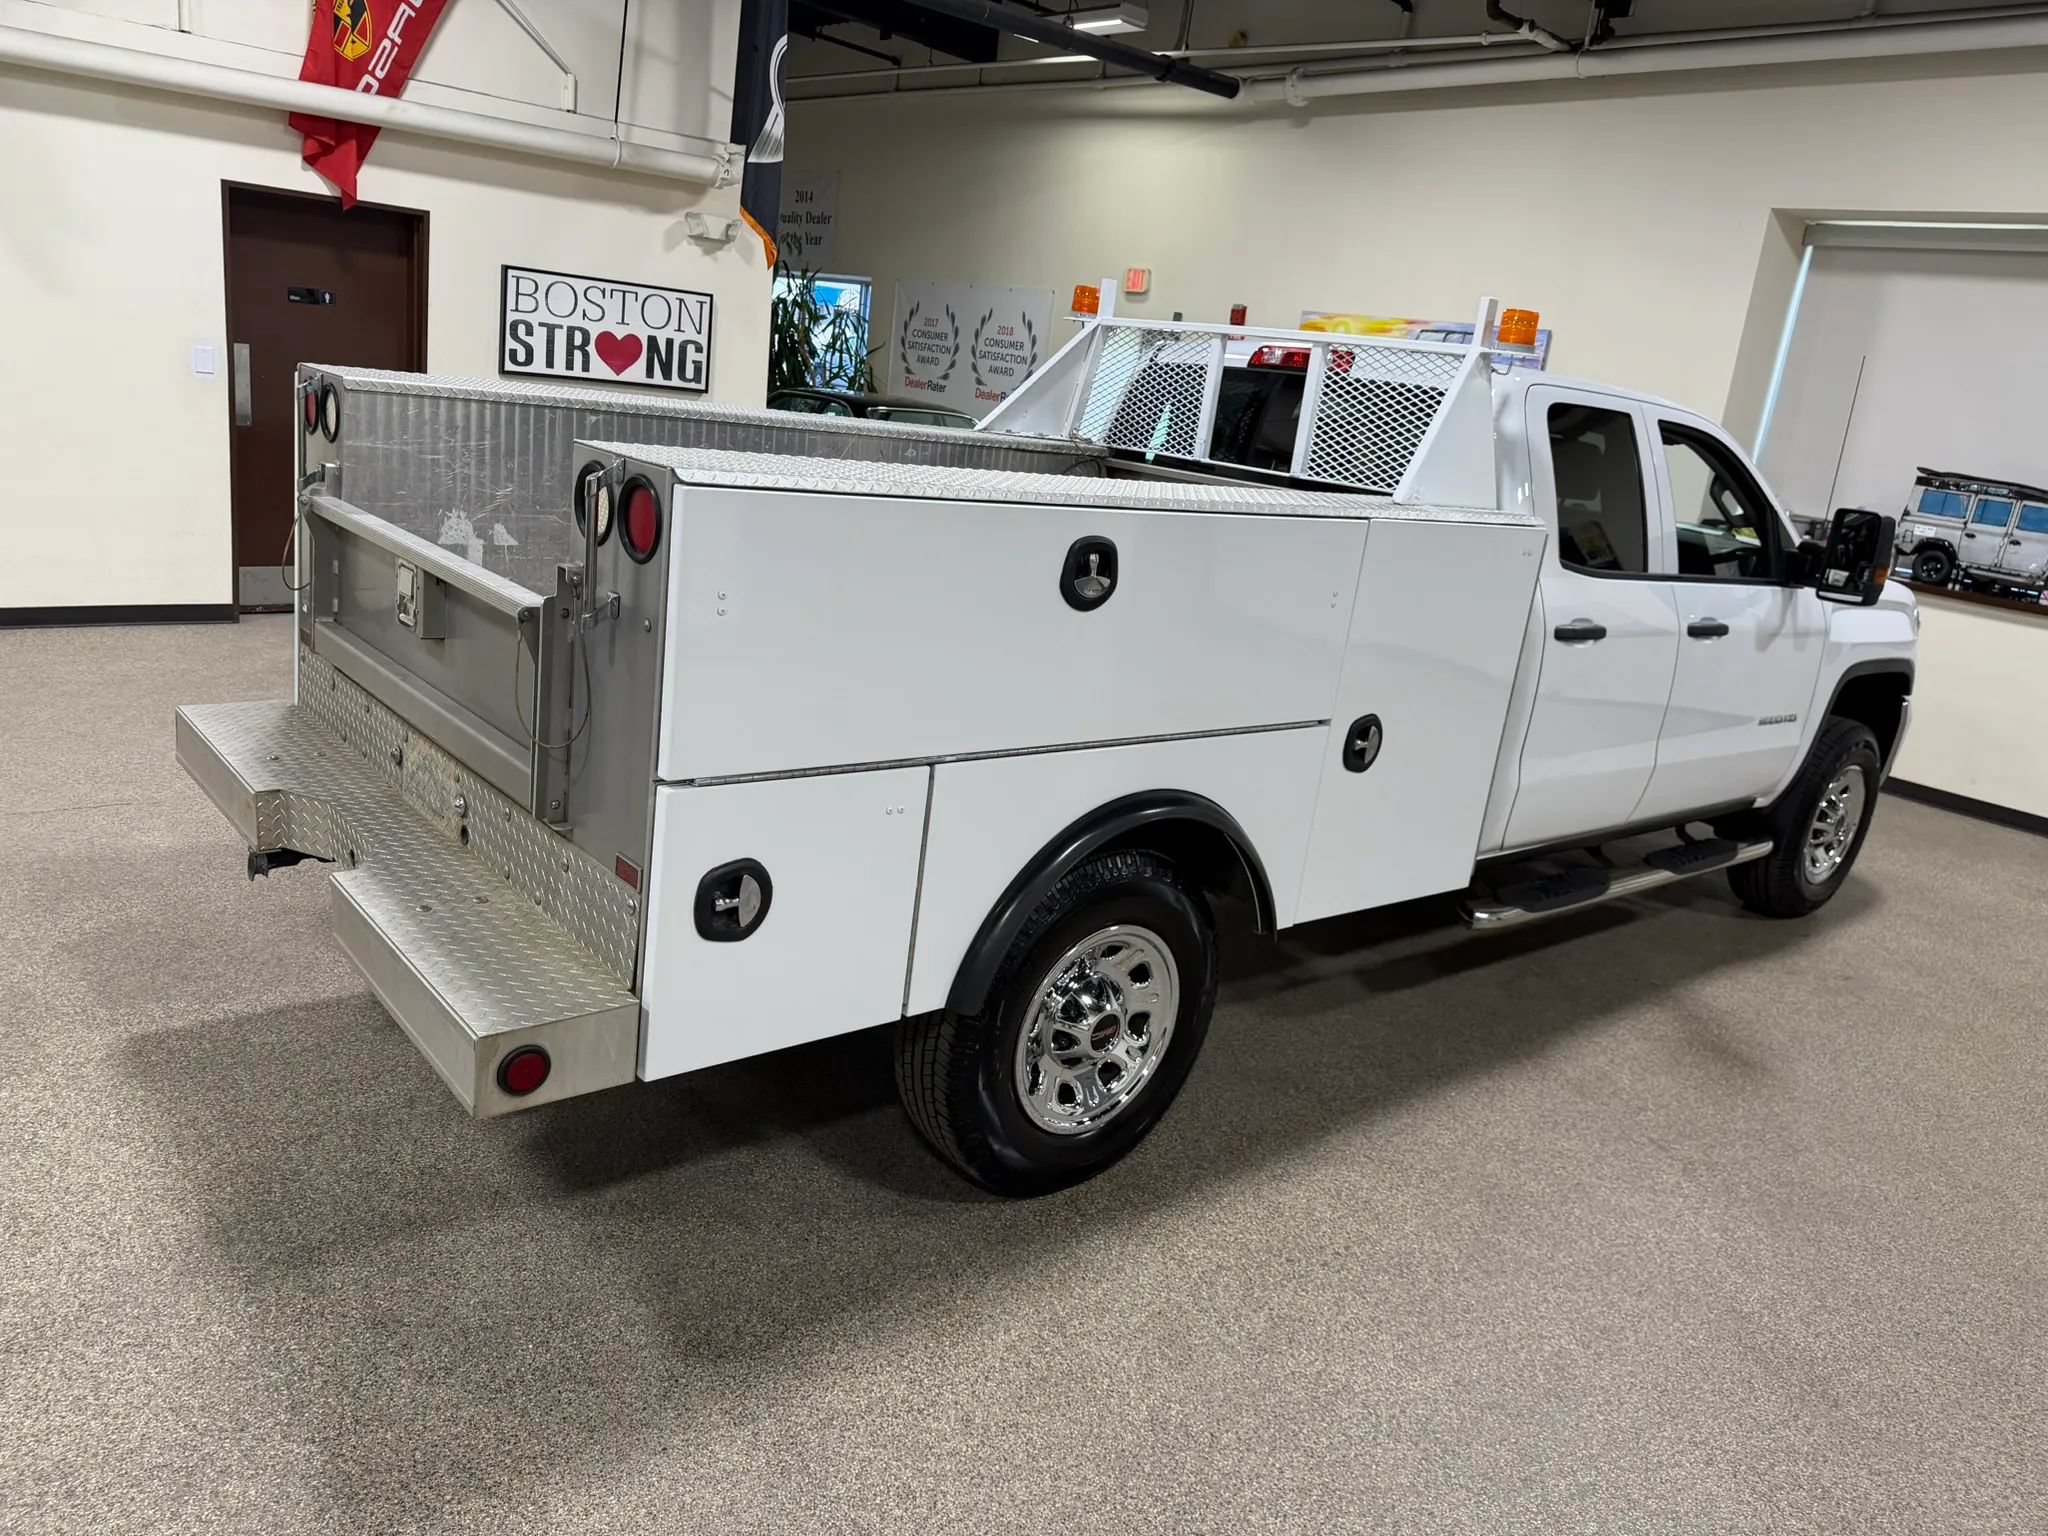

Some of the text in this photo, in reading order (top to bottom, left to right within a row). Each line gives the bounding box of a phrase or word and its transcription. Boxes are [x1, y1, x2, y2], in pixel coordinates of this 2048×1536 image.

[794, 190, 814, 203] 2014
[780, 211, 832, 228] uality Dealer
[804, 231, 823, 246] Year
[510, 275, 707, 334] BOSTON
[923, 317, 939, 328] 2017
[912, 328, 949, 341] CONSUMER
[997, 325, 1014, 336] 2018
[907, 340, 951, 355] SATISFACTION
[984, 337, 1025, 351] CONSUMER
[508, 319, 704, 385] STRNG
[978, 350, 1028, 365] SATISFACTION
[916, 355, 940, 367] AWARD
[988, 365, 1014, 377] AWARD
[904, 376, 946, 393] DealerRater
[974, 387, 1010, 402] DealerR
